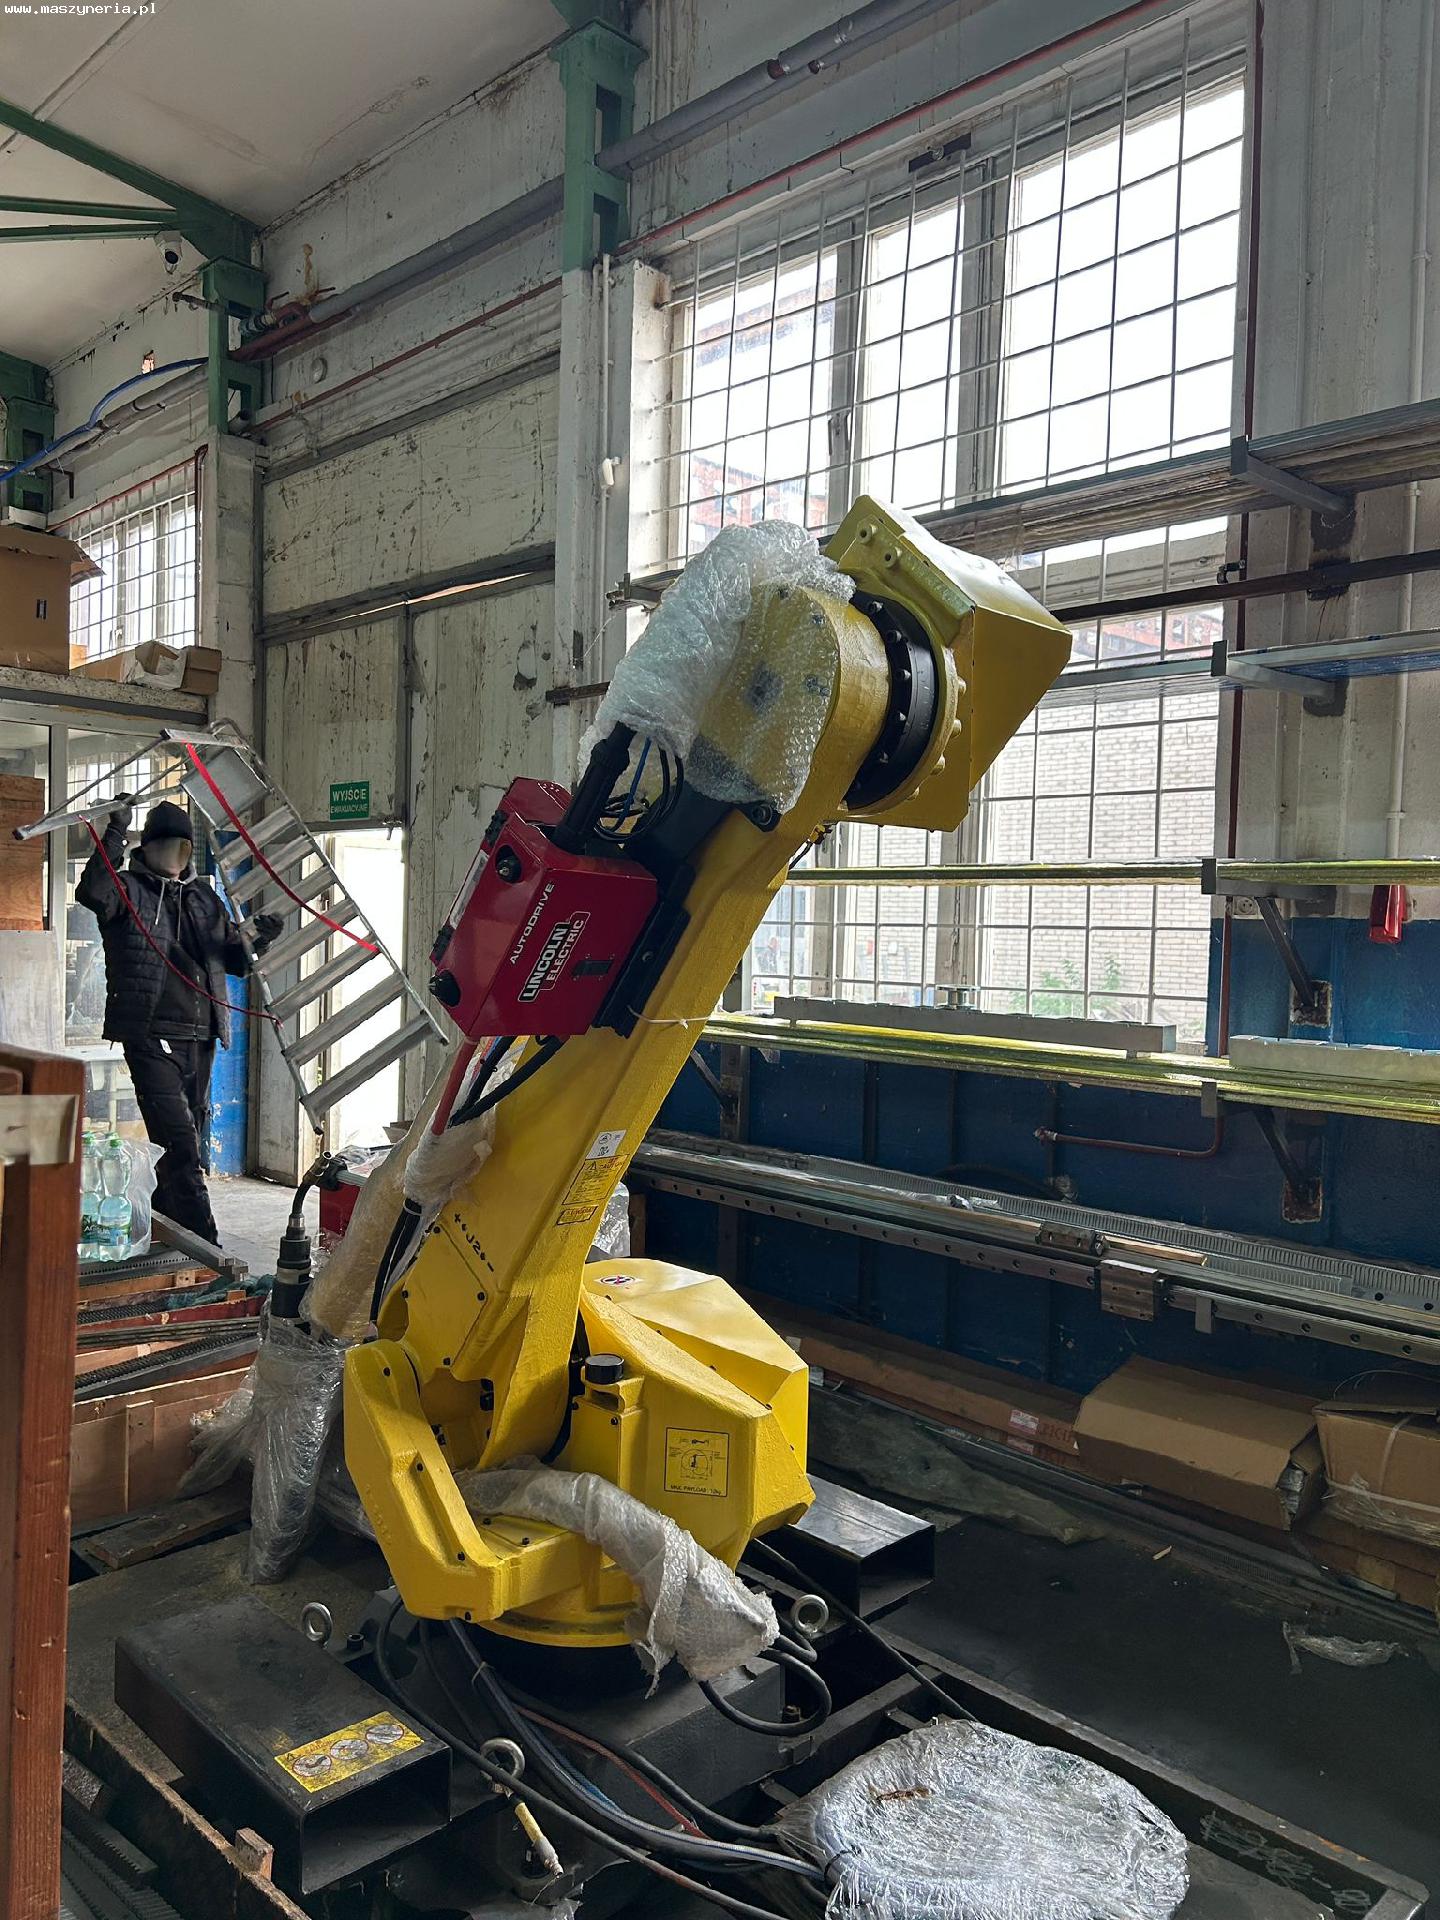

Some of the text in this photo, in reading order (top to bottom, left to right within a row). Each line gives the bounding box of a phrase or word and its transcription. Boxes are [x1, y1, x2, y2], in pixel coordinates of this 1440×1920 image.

[509, 883, 555, 965] AUTODRIVE
[545, 920, 584, 981] ELECTRIC
[522, 928, 568, 998] LINCOLN
